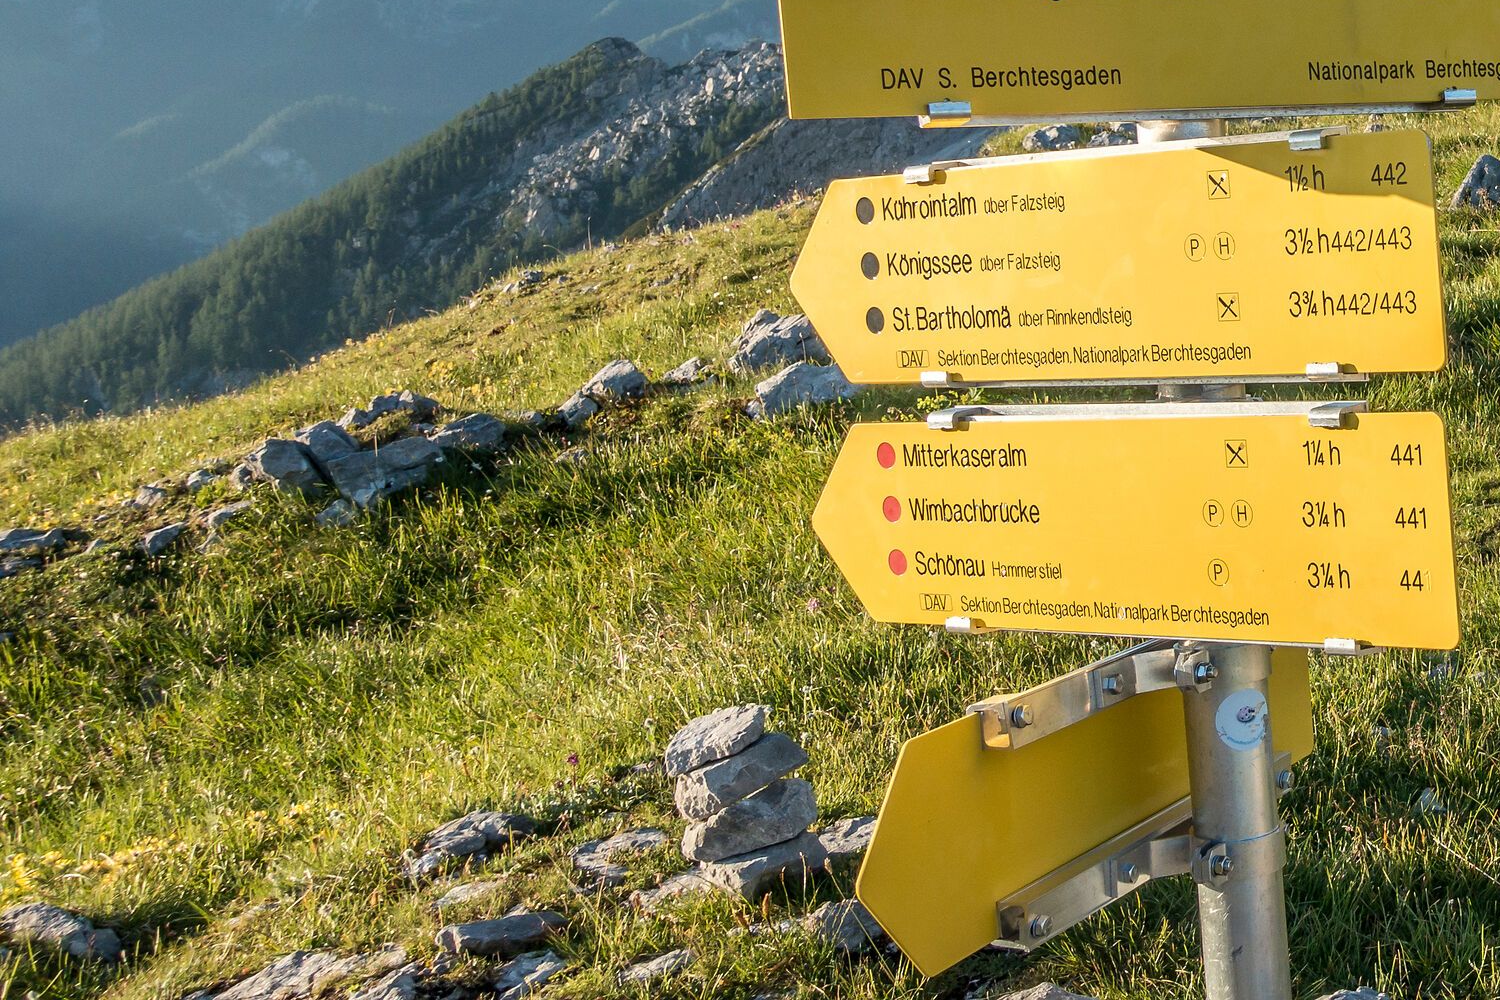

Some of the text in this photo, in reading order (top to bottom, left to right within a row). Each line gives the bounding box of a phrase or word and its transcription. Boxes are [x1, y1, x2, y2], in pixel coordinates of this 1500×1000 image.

[881, 66, 1121, 90] DAV S. Berchtesgaden
[1309, 60, 1414, 83] Nationalpark
[1312, 164, 1324, 190] h
[1371, 162, 1407, 186] 442
[882, 192, 976, 221] Kührointalm
[1011, 193, 1065, 212] Falzsteig
[887, 251, 972, 280] Königssee
[1007, 251, 1061, 271] Falzsteig
[1046, 307, 1132, 327] Rinnkendlsteig
[901, 350, 924, 368] DAV
[903, 443, 1027, 468] Mitterkaseralm
[1329, 440, 1340, 466] h
[1391, 444, 1421, 466] 441
[909, 498, 1040, 524] Wimbachbrücke
[1333, 502, 1345, 527] h
[1395, 507, 1426, 529] 441
[915, 551, 1062, 579] Schönau Hammerstiel
[1338, 563, 1350, 589] h
[924, 594, 947, 611] DAV
